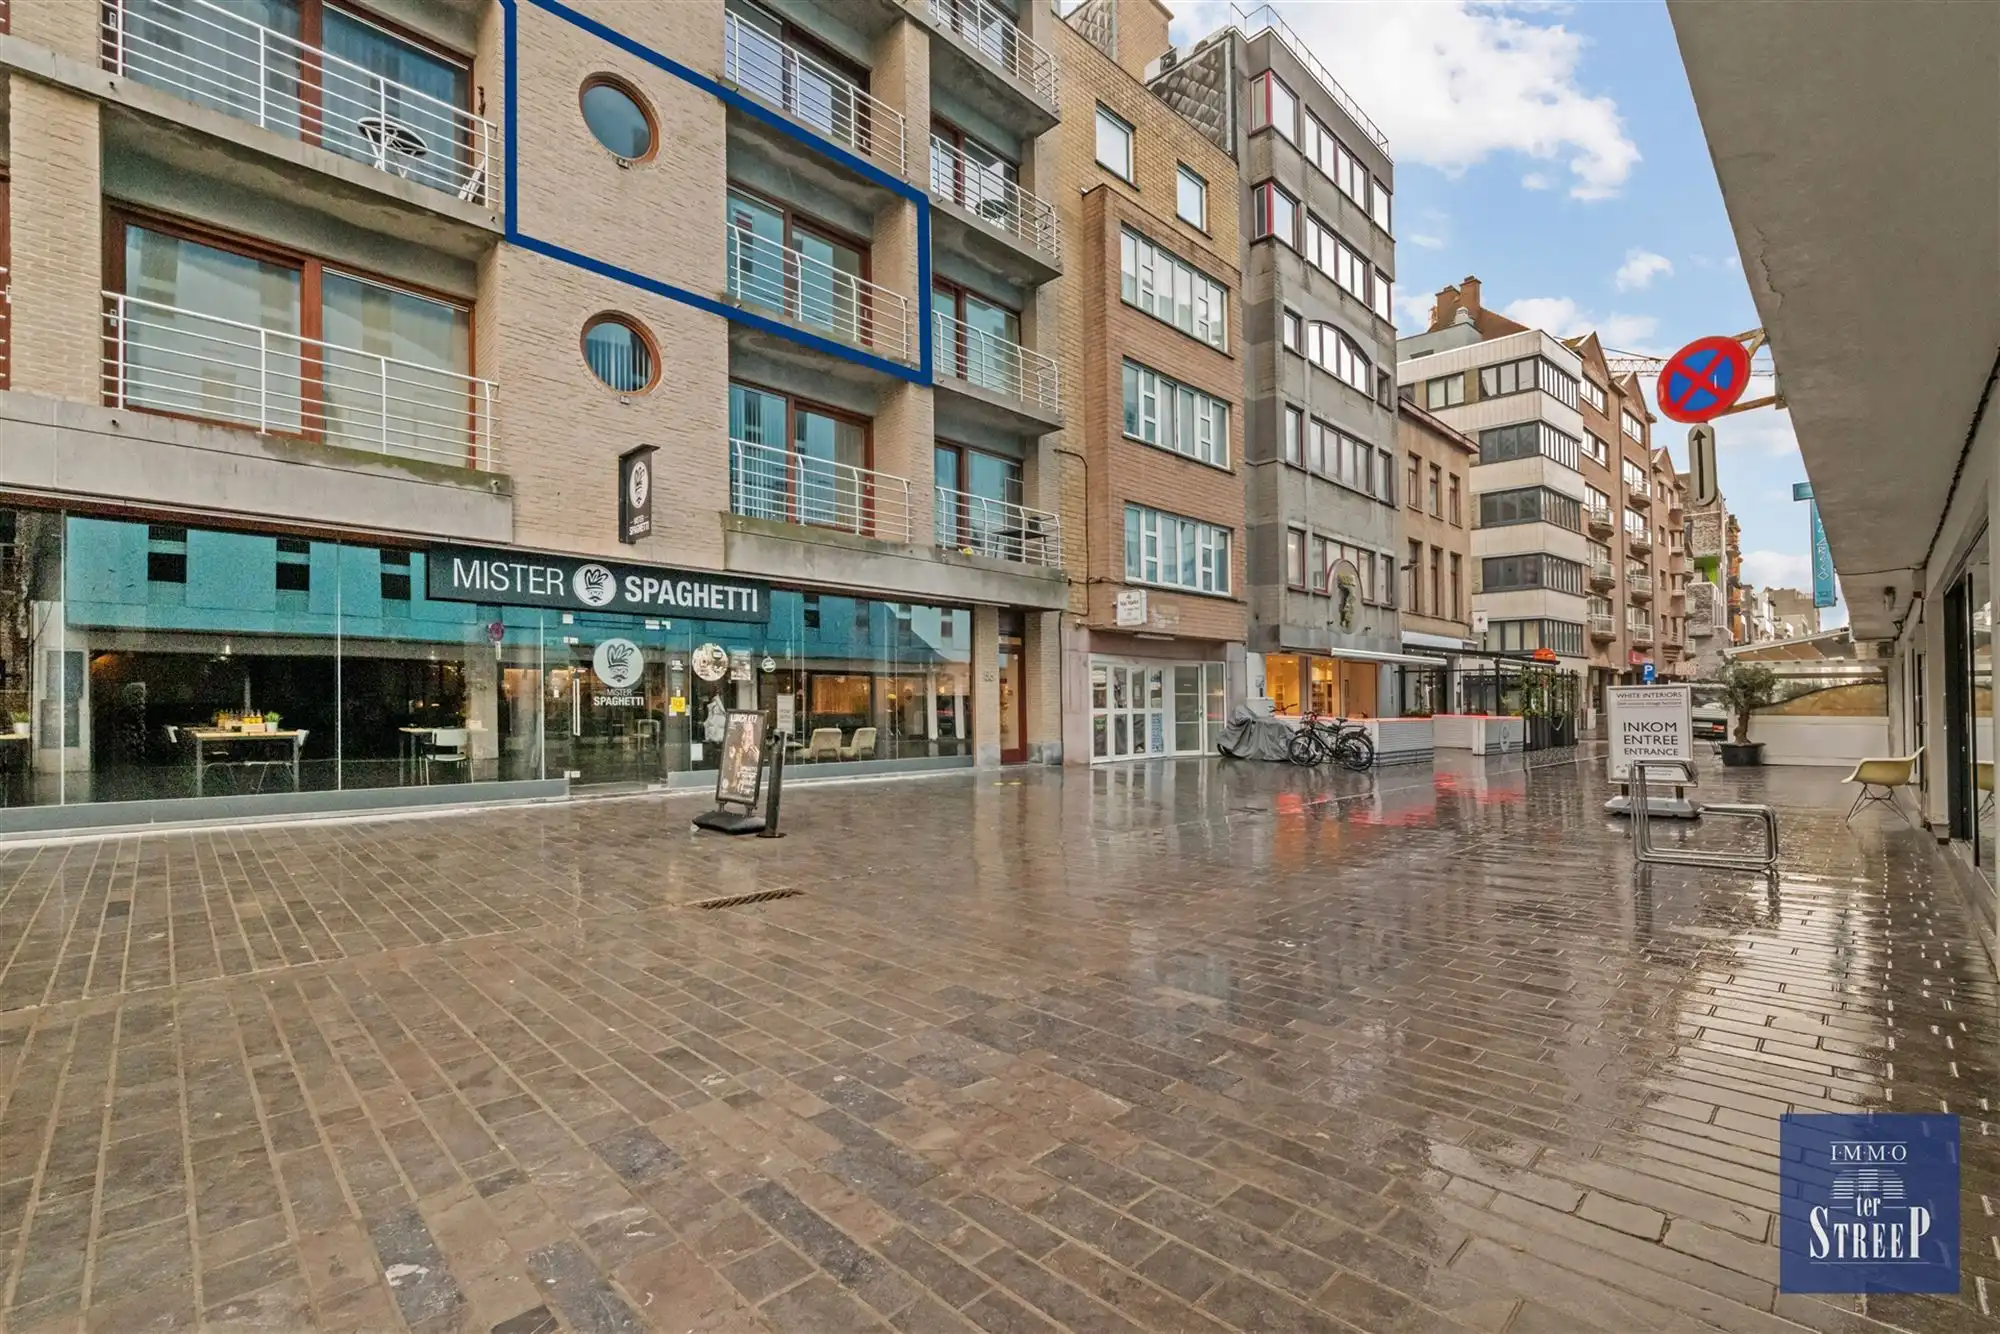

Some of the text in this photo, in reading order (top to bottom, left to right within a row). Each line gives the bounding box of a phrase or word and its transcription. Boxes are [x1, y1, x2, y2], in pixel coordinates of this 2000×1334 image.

[453, 558, 758, 612] MISTER SPAGHETTI
[1644, 665, 1653, 675] P
[606, 688, 633, 697] MISTER
[1642, 691, 1683, 699] INTERIORS
[594, 696, 645, 707] SPAGHETTI
[1623, 721, 1678, 733] INKOM
[1623, 734, 1679, 746] ENTREE
[1624, 747, 1680, 757] ENTRANCE
